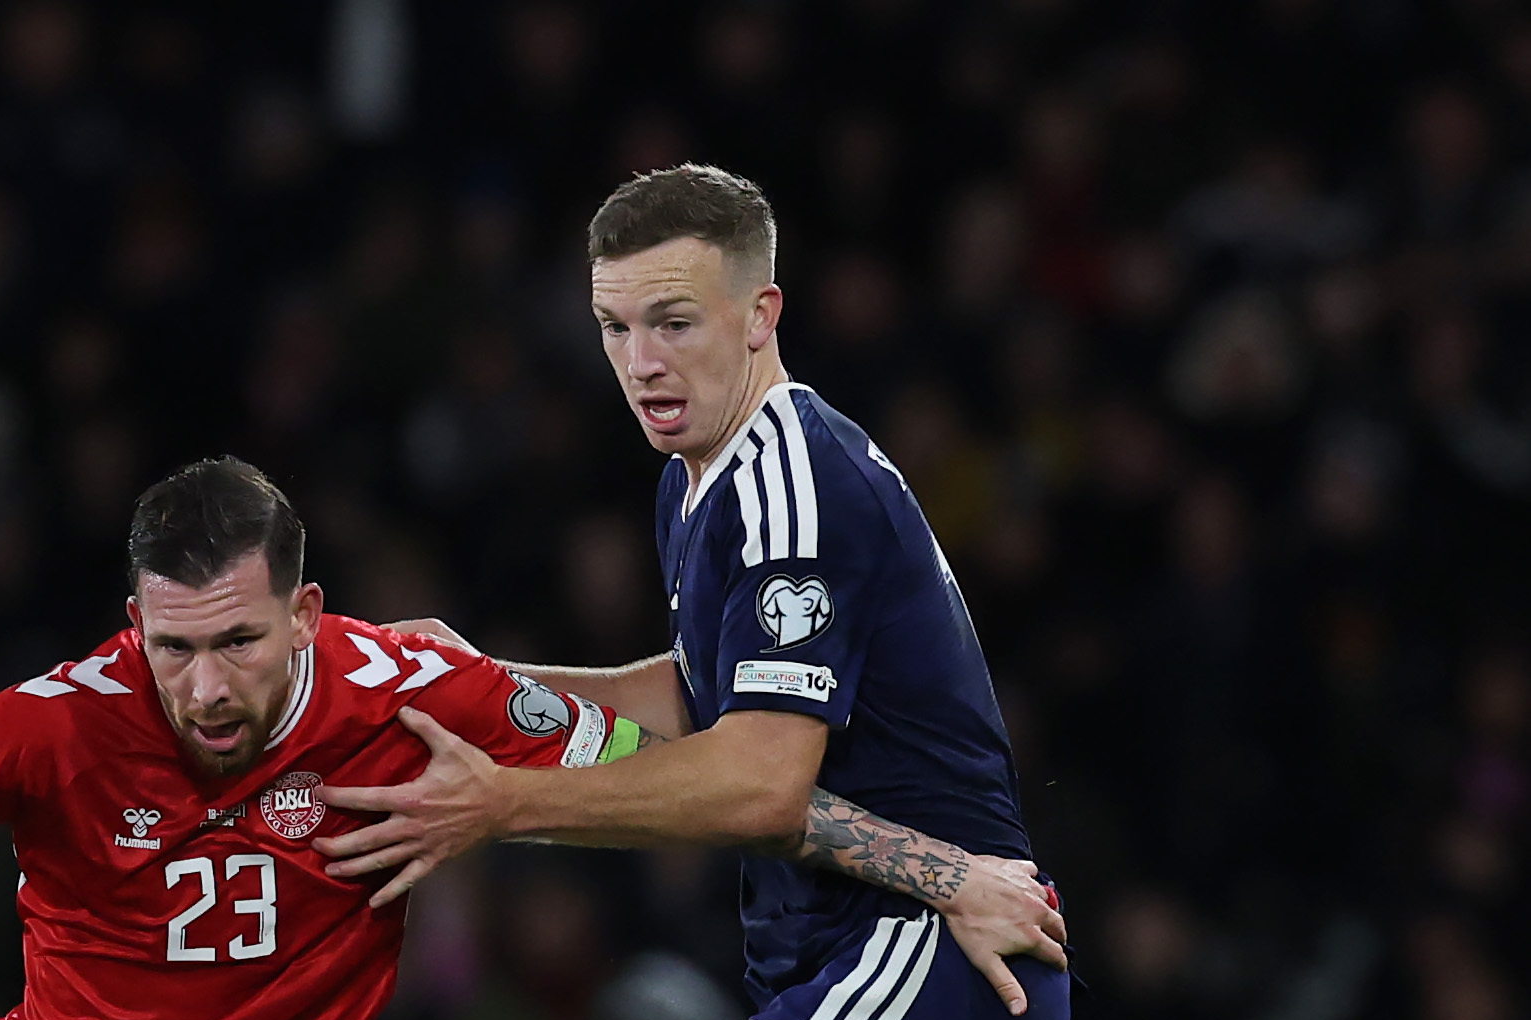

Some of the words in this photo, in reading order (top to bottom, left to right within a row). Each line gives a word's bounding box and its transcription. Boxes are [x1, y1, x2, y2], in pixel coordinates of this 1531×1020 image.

[737, 672, 803, 684] FOUNDATION
[274, 788, 312, 811] DBU
[283, 824, 308, 836] 1889
[114, 834, 160, 850] hummel
[164, 854, 277, 961] 23
